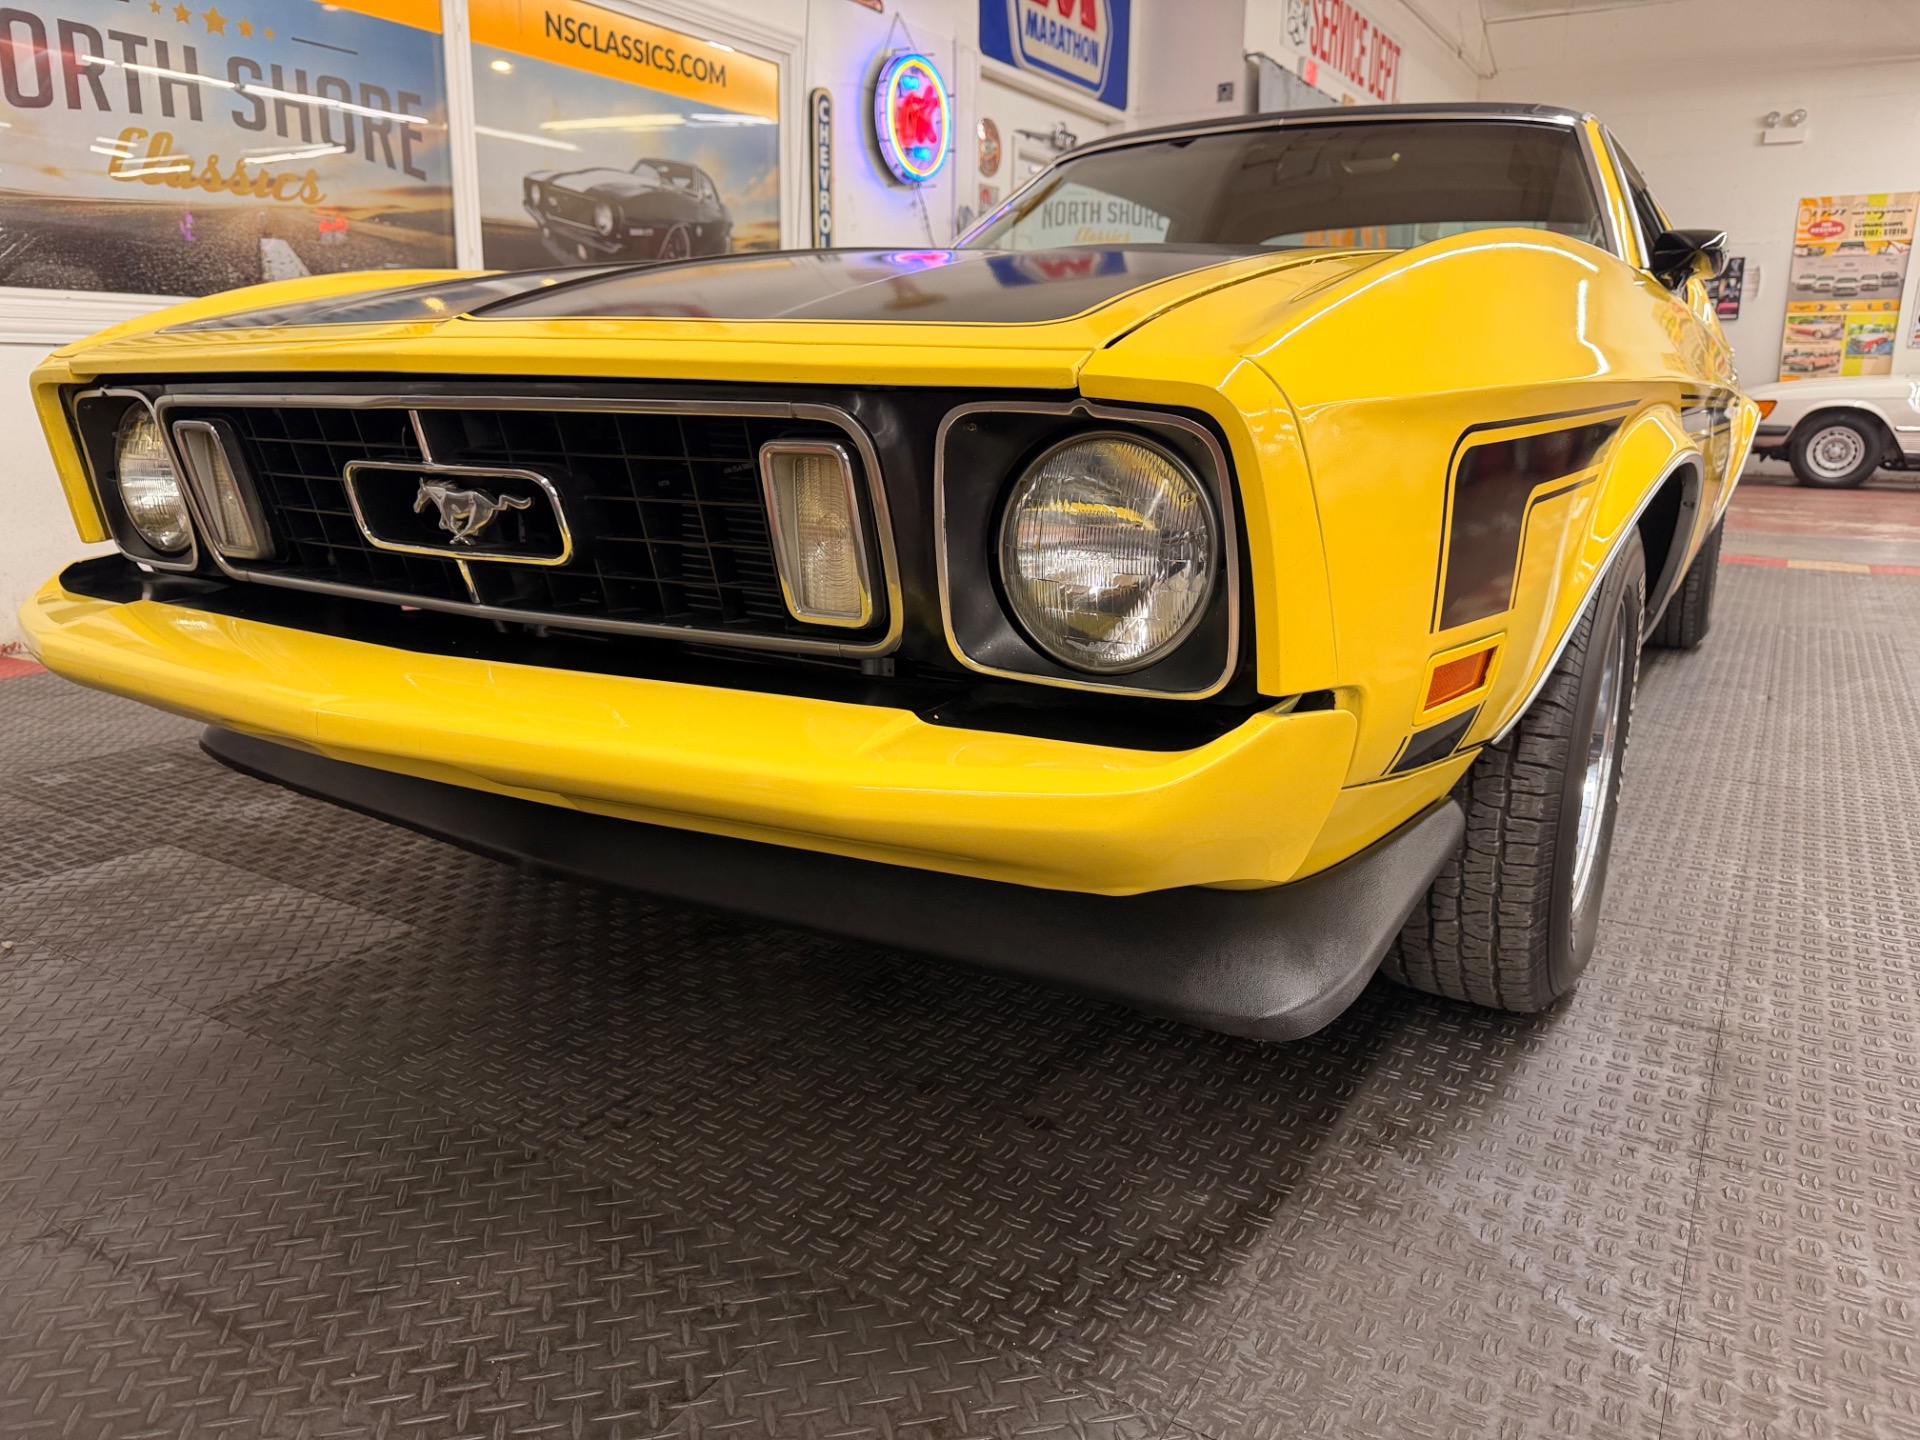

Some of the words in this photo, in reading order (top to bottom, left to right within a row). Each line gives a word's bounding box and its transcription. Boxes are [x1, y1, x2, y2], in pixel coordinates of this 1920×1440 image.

[545, 10, 727, 88] NSCLASSICS.COM
[1025, 8, 1099, 68] MARATHON
[1309, 0, 1366, 87] SERVICE
[226, 56, 428, 181] SHORE
[108, 127, 327, 204] Classics
[1042, 201, 1101, 229] NORTH
